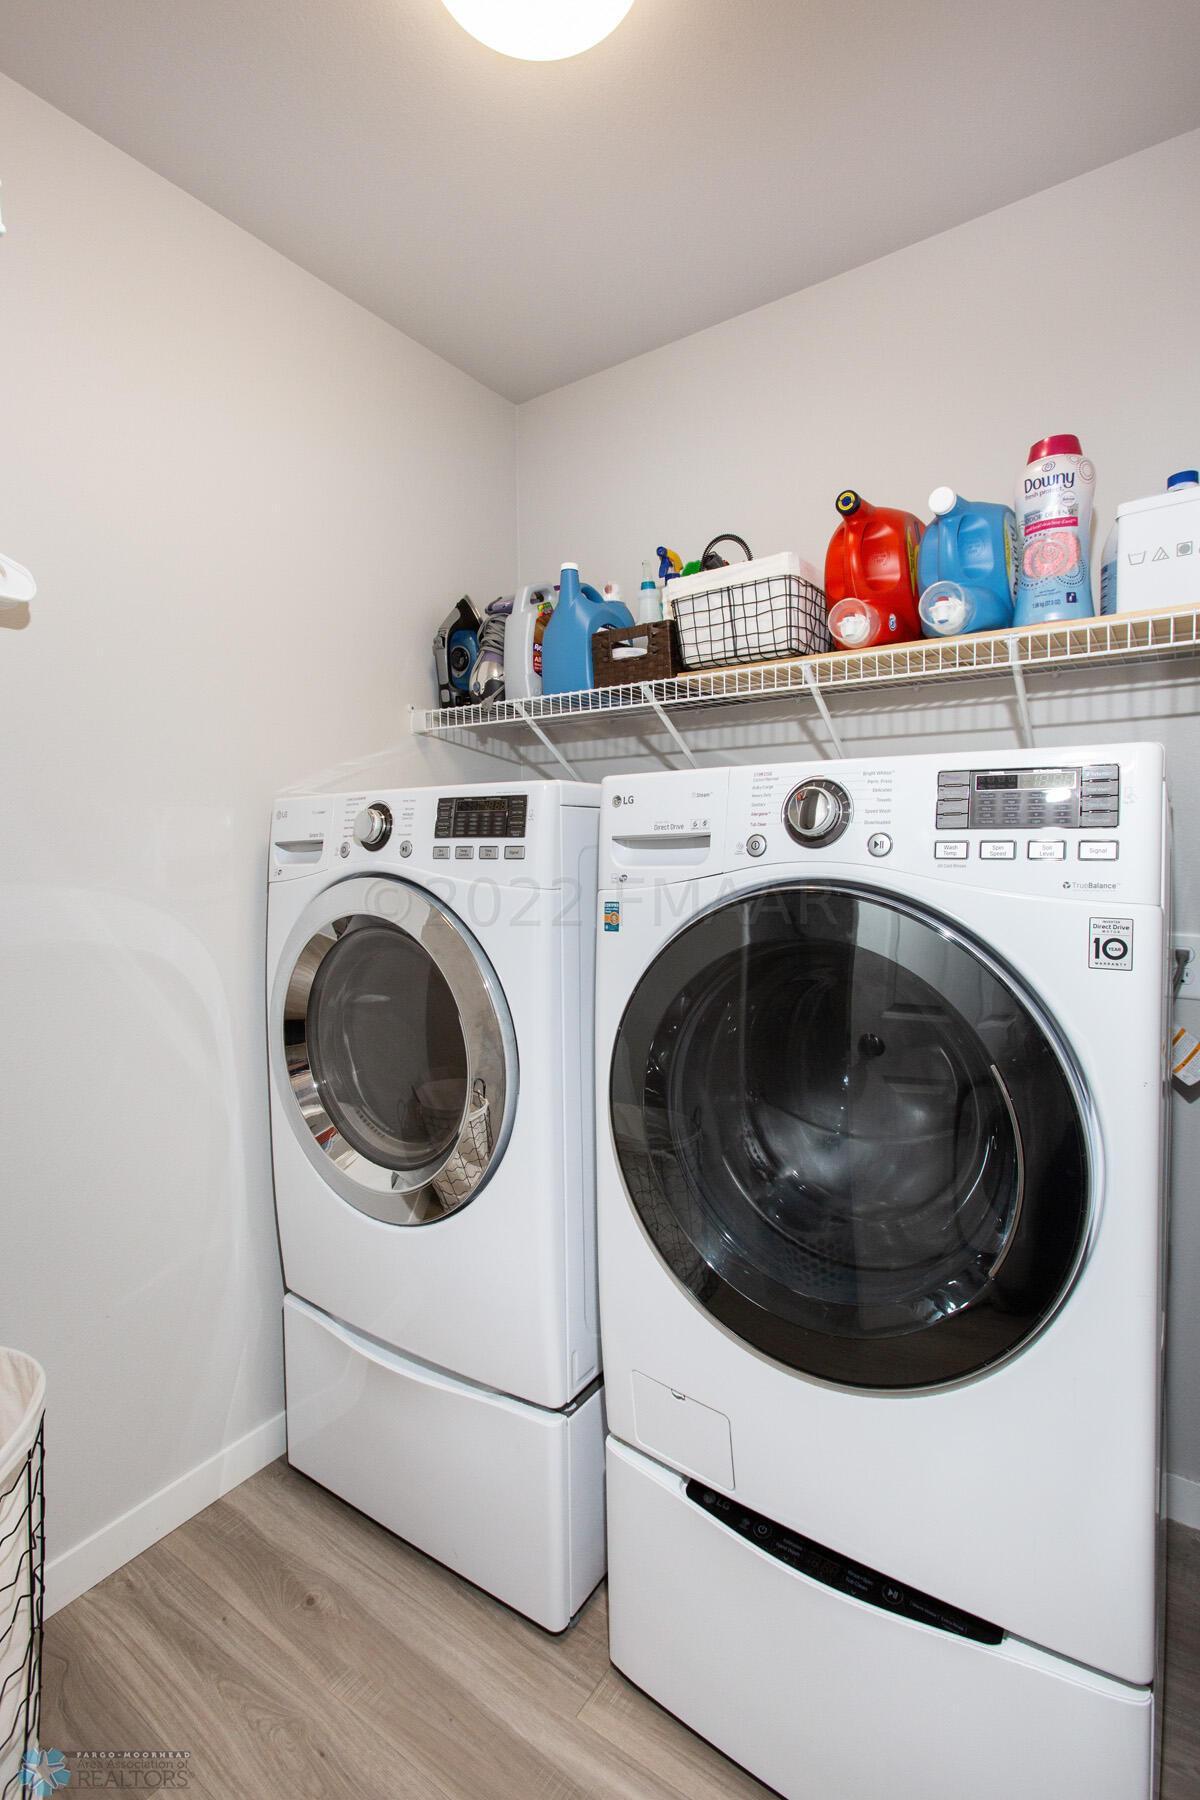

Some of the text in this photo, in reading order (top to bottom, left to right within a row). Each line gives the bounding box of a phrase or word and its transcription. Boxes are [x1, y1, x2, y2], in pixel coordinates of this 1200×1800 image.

[1024, 472, 1075, 494] Downy
[622, 795, 635, 806] LG
[653, 822, 685, 831] Direct Drive
[1089, 847, 1108, 855] Signal
[1093, 937, 1129, 961] 10
